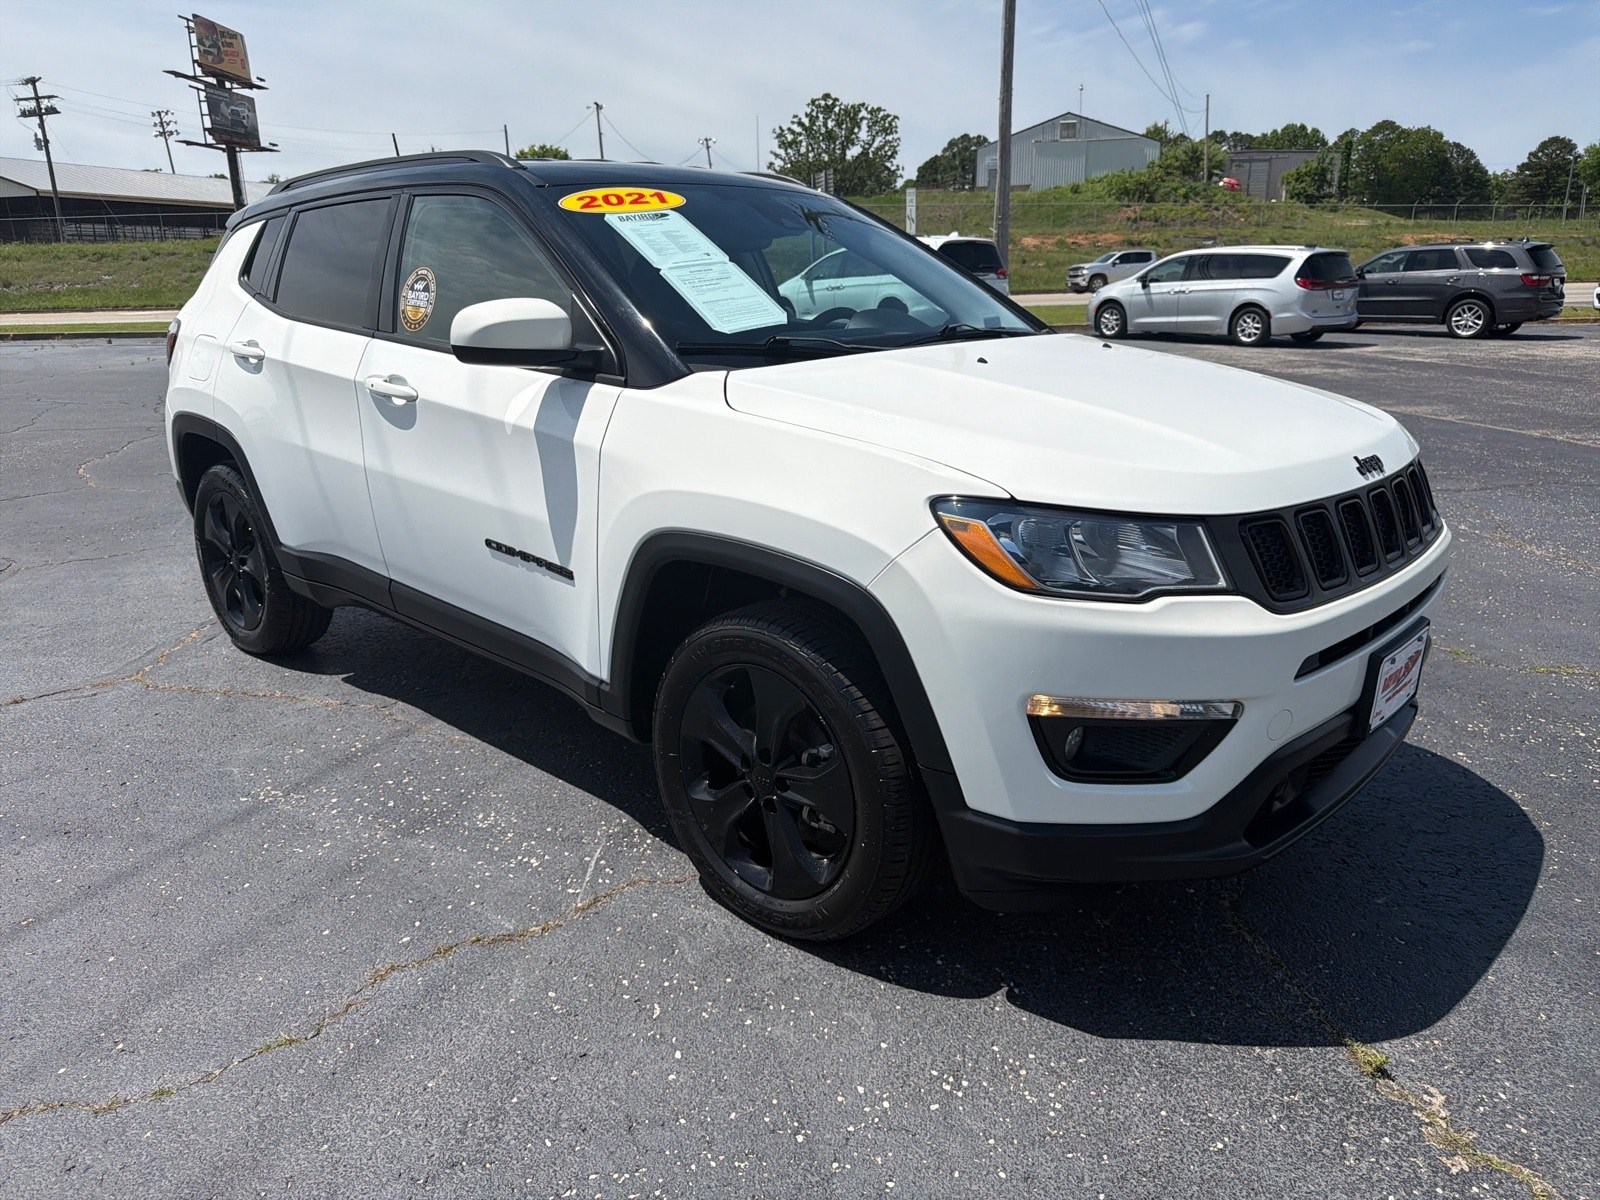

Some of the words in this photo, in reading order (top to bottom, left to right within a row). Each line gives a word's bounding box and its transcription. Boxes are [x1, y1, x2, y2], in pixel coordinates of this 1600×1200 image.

[576, 191, 670, 210] 2021
[617, 212, 656, 223] BAYIRD
[407, 290, 429, 300] BAYIRD
[1353, 454, 1384, 474] Jeep
[485, 538, 575, 581] COMPASS
